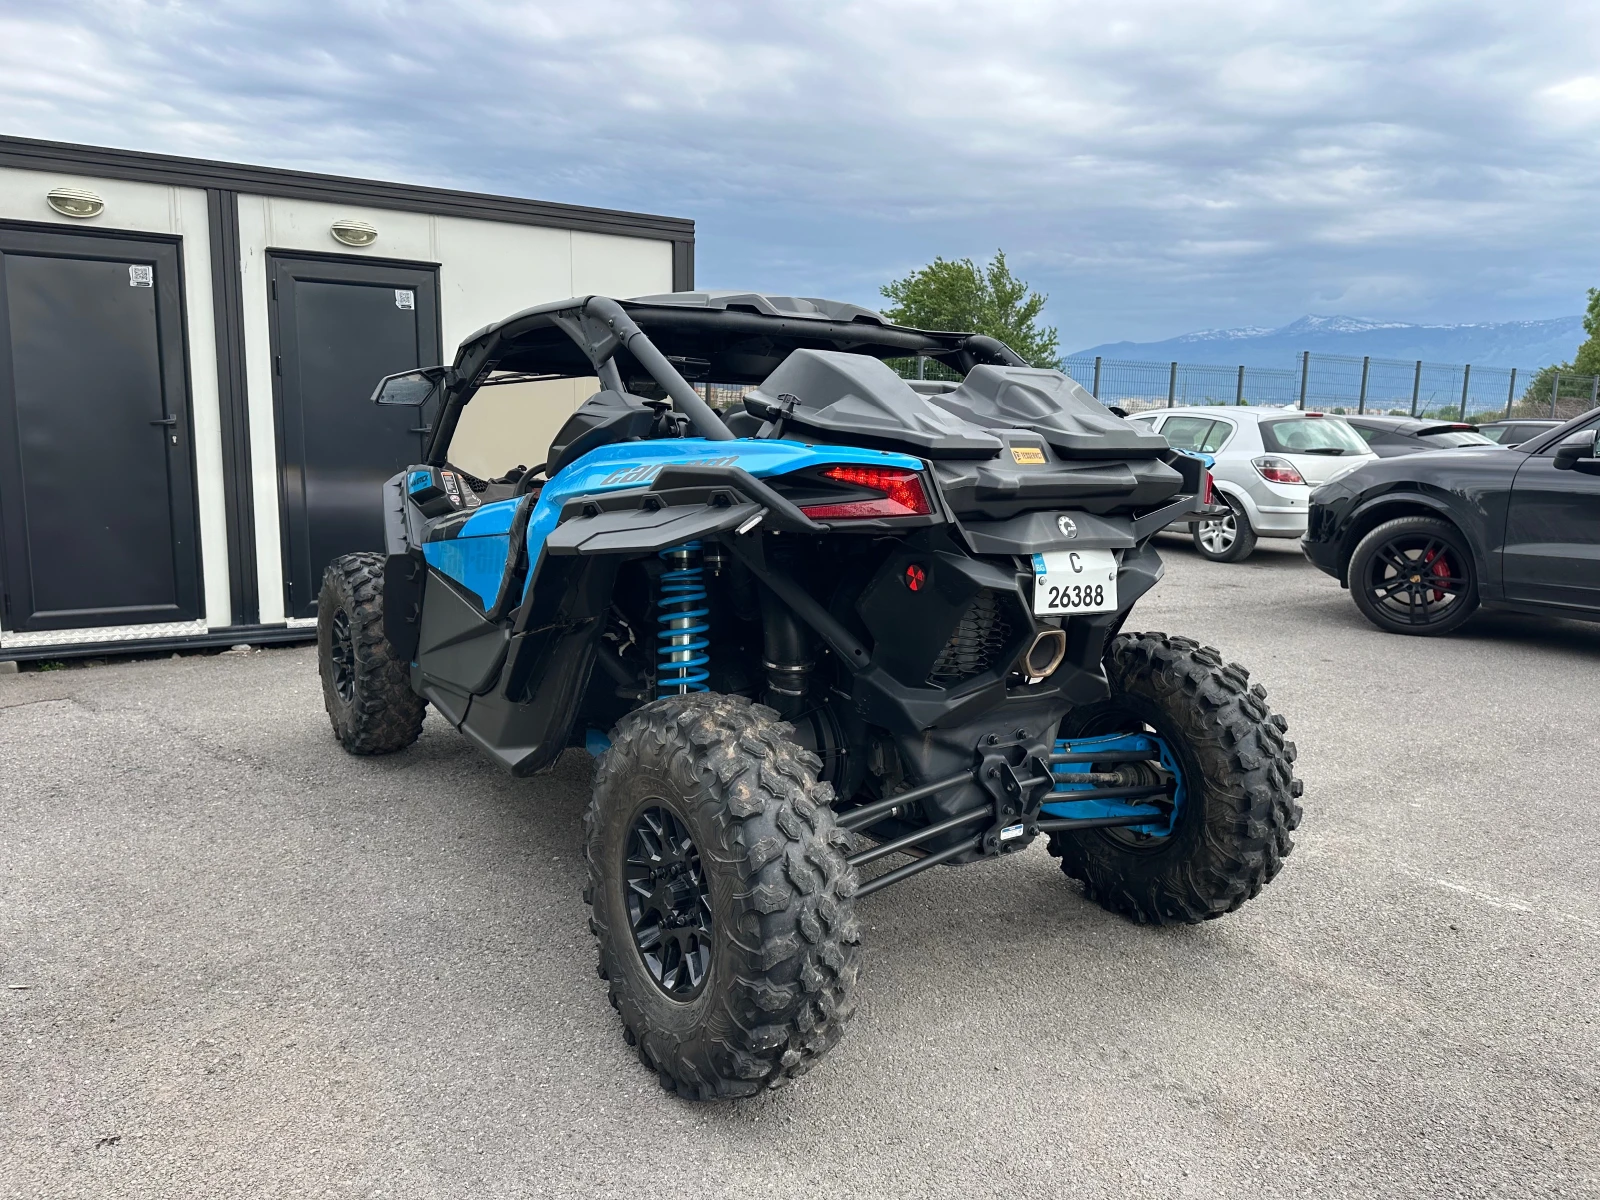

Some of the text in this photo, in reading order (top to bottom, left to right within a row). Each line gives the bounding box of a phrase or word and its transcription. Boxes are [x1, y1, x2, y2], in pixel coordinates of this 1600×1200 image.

[1035, 564, 1046, 572] BG
[1069, 552, 1083, 573] C
[1048, 584, 1104, 608] 26388
